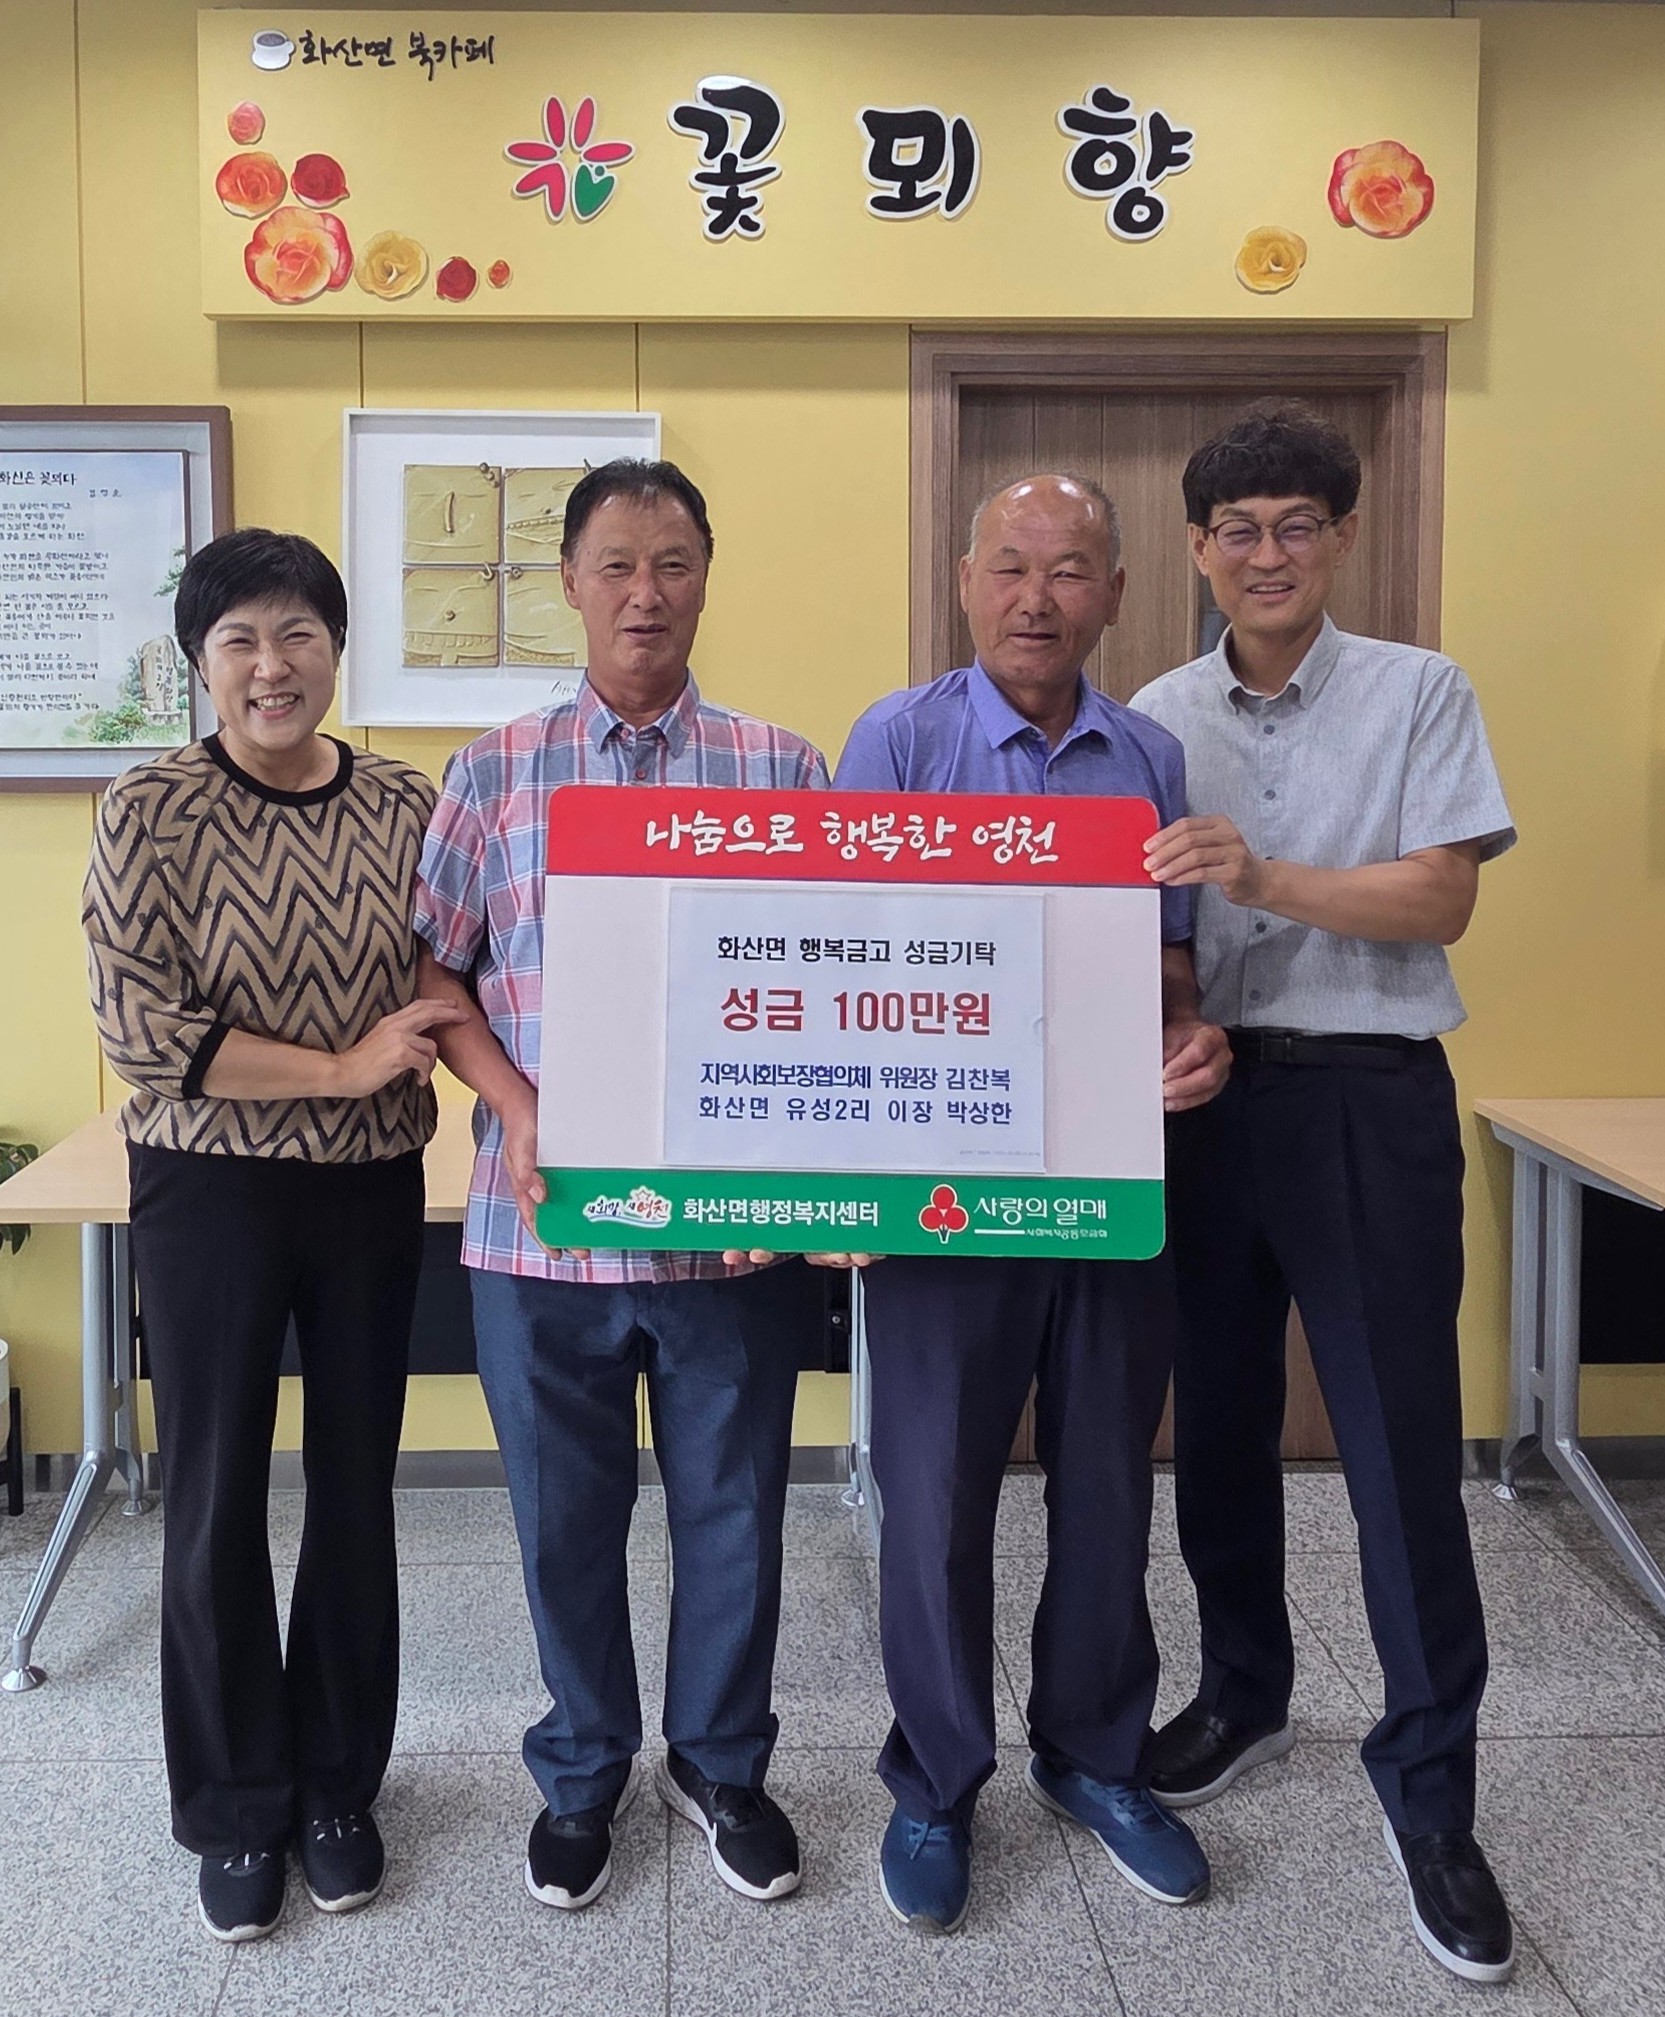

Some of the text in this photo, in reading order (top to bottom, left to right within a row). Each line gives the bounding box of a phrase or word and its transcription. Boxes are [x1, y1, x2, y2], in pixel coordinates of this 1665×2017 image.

[299, 29, 495, 82] 화산면 북카페
[674, 78, 1193, 240] 꽃 뫼 향
[646, 809, 1059, 865] 나눔으로 행복한 영천
[717, 936, 997, 967] 화산면 행복금고 성금기탁
[722, 987, 990, 1036] 성금 100만원
[700, 1062, 1011, 1092] 지역사회보장협의체 위원장 김찬복
[699, 1095, 1012, 1126] 화산면 유성2리 이장 박상한
[683, 1198, 879, 1227] 화산면행정복지센터
[973, 1196, 1107, 1226] 사랑의 열매
